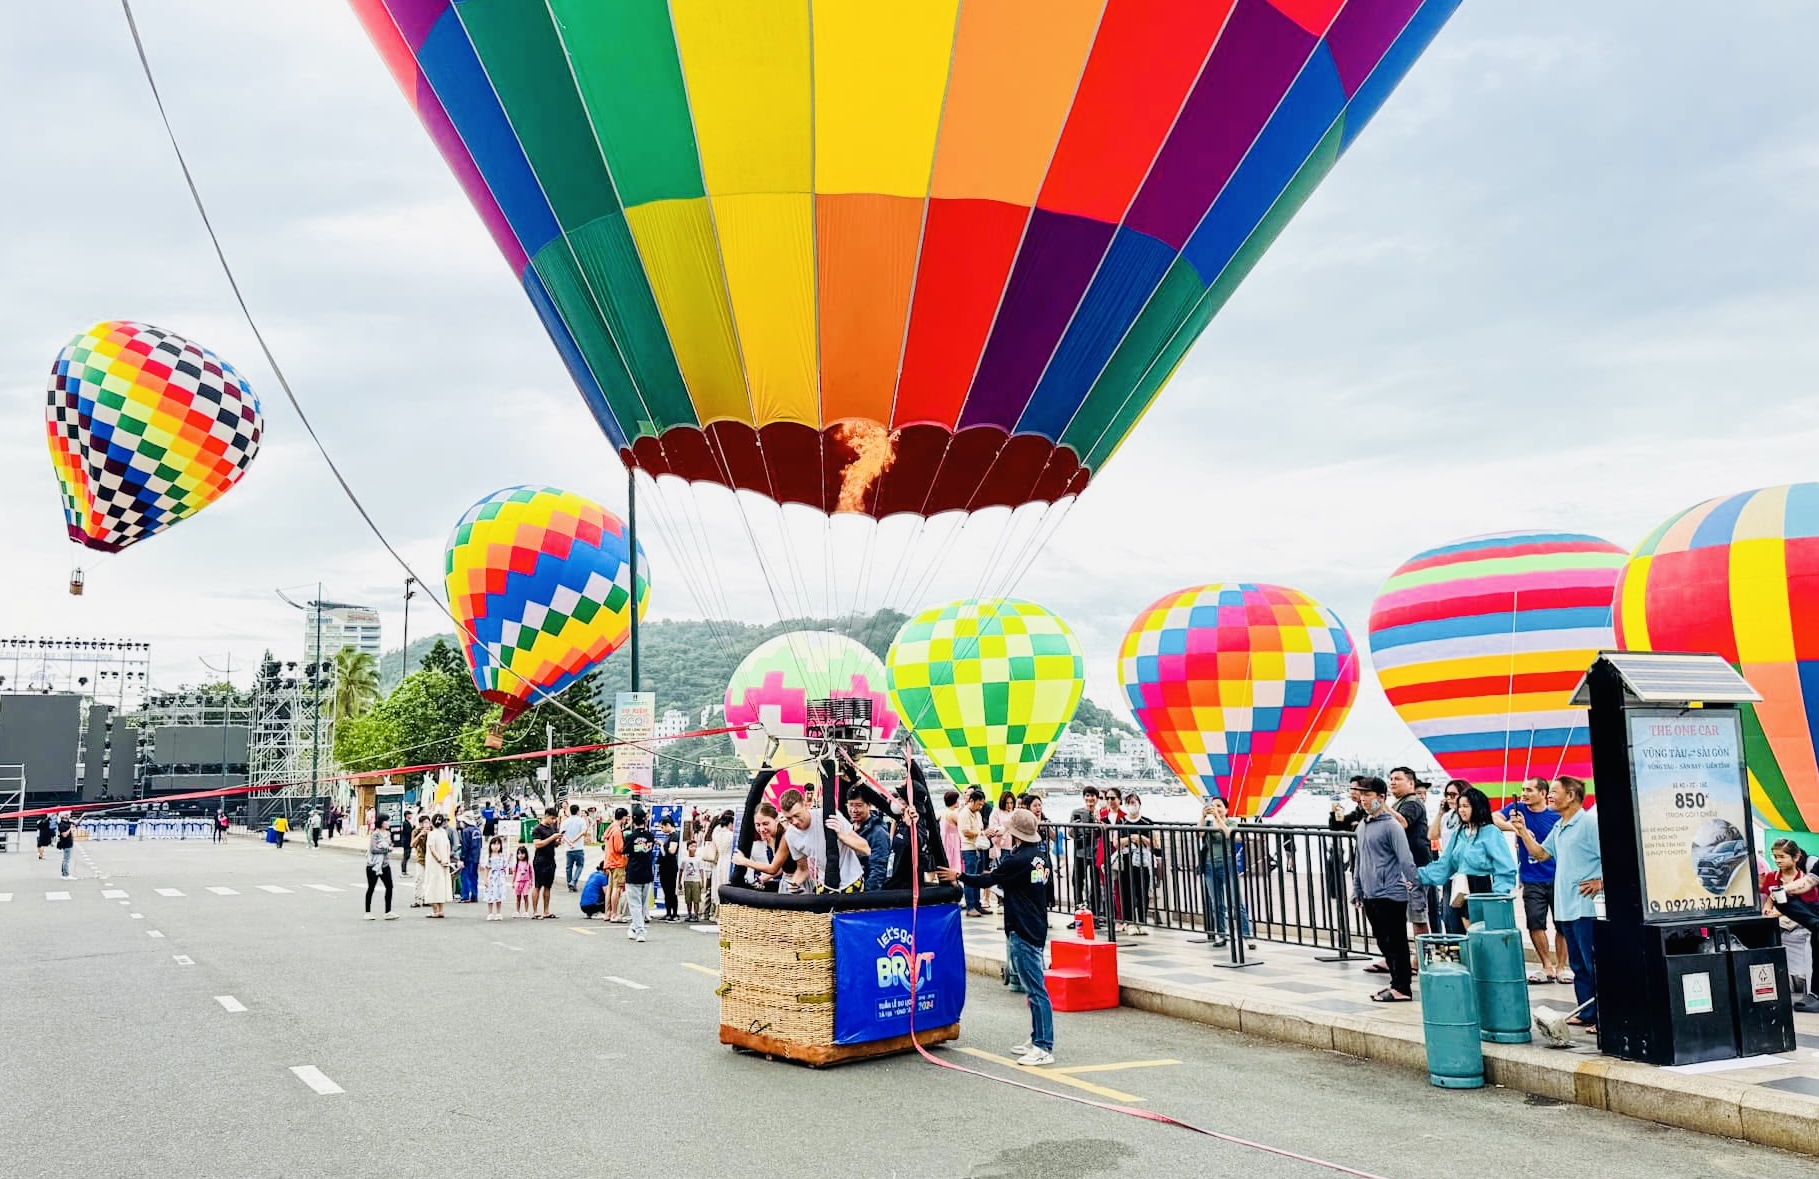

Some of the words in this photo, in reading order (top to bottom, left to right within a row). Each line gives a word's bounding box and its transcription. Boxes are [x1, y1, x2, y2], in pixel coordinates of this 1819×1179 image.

[1649, 725, 1673, 736] THE
[1674, 724, 1697, 736] ONE
[1698, 724, 1719, 736] CAR
[1642, 747, 1667, 758] VŨNG
[1669, 746, 1687, 758] TÀU
[1697, 745, 1711, 758] SÀI
[1711, 745, 1730, 758] GÒN
[918, 1000, 934, 1011] 2024
